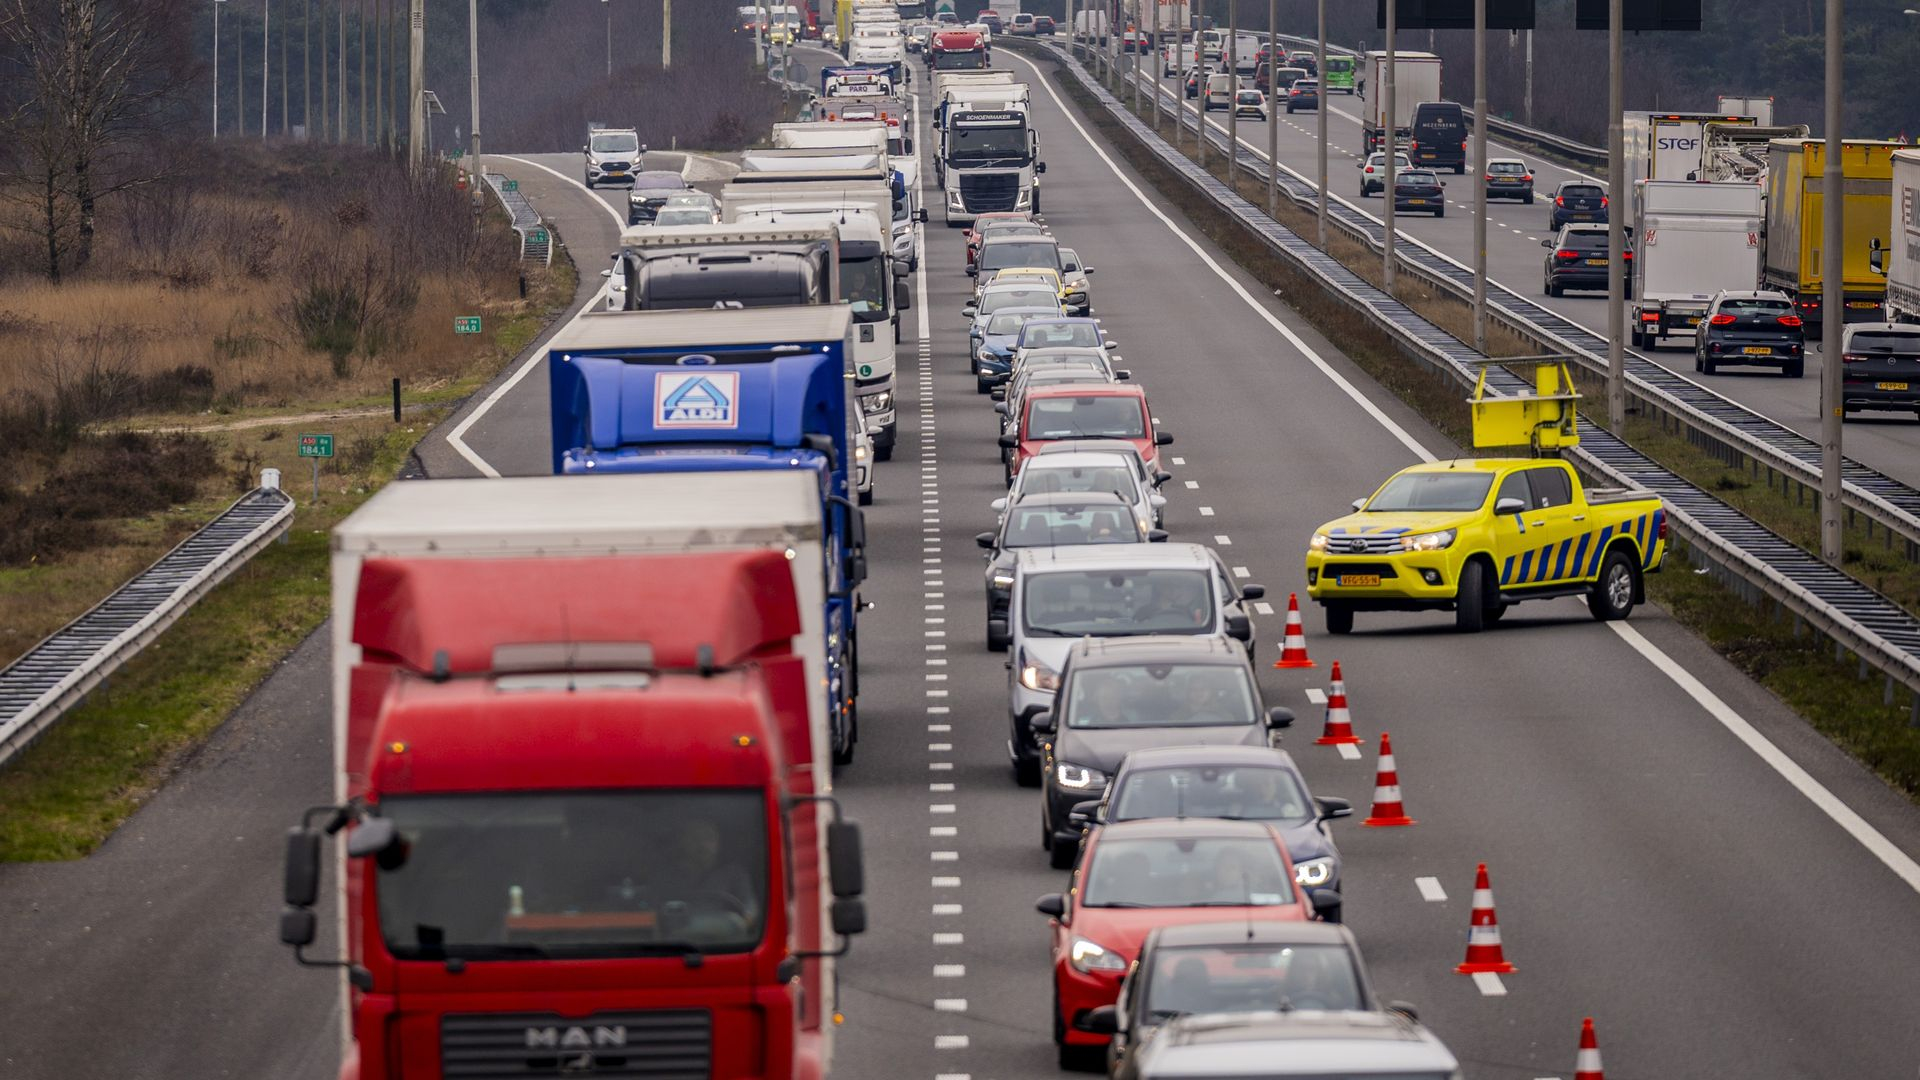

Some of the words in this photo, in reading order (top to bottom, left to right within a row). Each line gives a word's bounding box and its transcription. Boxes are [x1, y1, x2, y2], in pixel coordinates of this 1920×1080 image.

[667, 408, 724, 420] ALDI
[302, 446, 325, 455] 184,1
[525, 1026, 627, 1047] MAN
